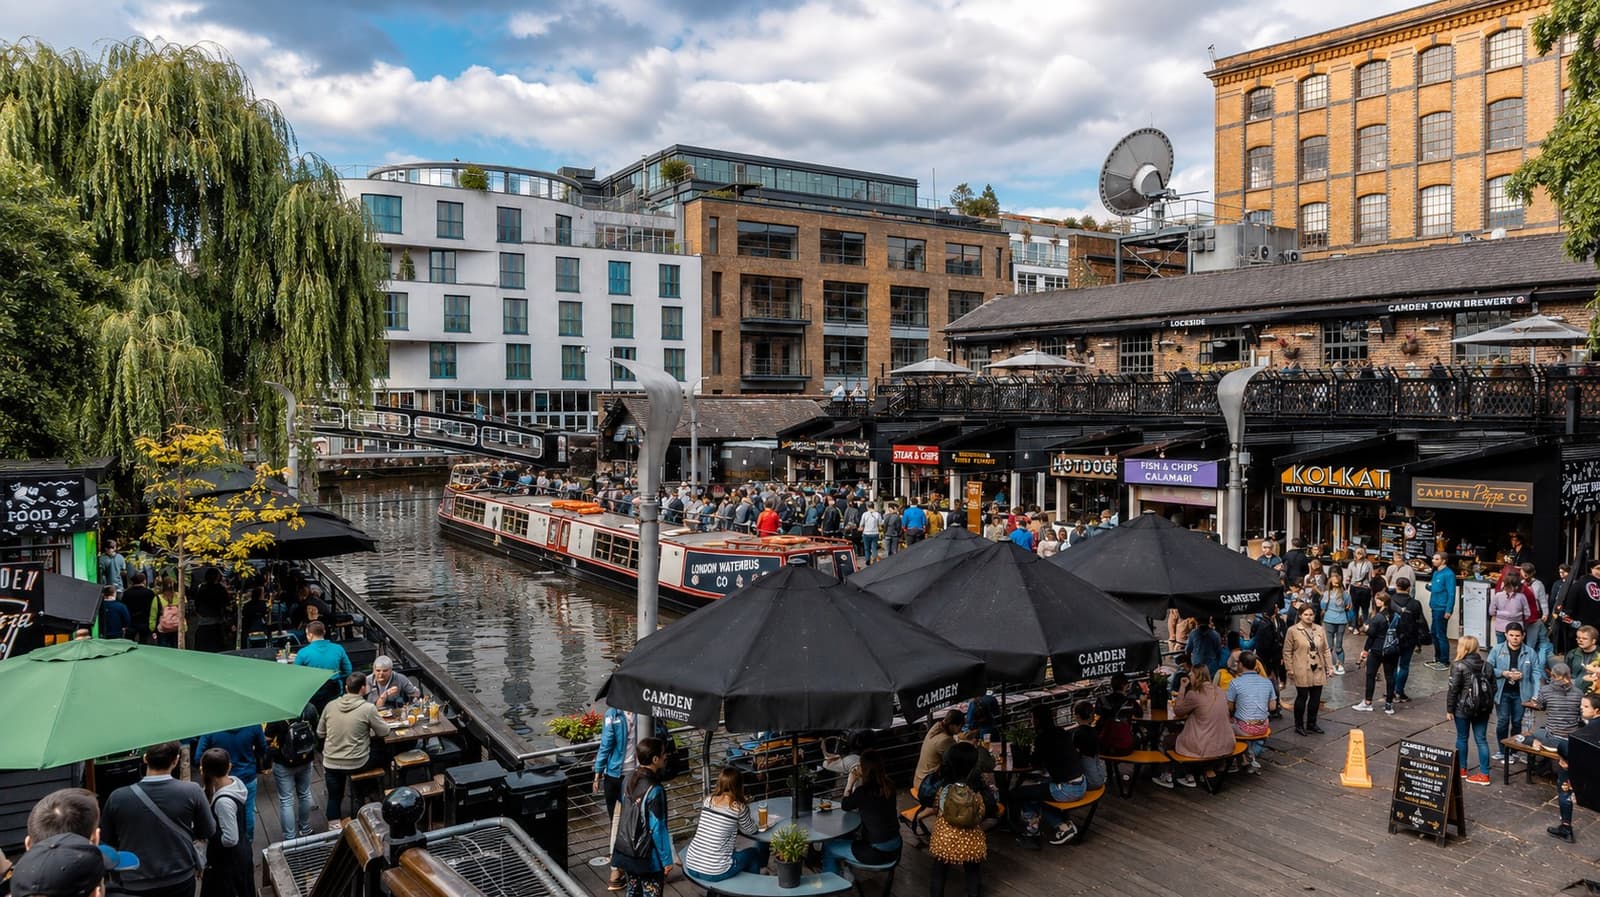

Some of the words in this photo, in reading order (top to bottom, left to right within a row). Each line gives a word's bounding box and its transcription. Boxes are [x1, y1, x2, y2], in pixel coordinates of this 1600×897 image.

[1388, 302, 1428, 312] CAMDEN
[1431, 299, 1461, 309] TOWN
[1463, 296, 1514, 308] BREWERY
[894, 450, 913, 460] STEAK
[1141, 462, 1160, 471] FISH
[1162, 463, 1169, 471] &
[1171, 463, 1199, 472] CHIPS
[1145, 472, 1193, 483] CALAMARI
[1417, 488, 1470, 499] CAMDEN
[1508, 493, 1528, 502] CO
[691, 562, 718, 574] LONDON
[716, 575, 728, 587] CO
[1078, 648, 1126, 665] CAMDEN
[1081, 661, 1126, 678] MARKET
[642, 688, 693, 711] CAMDEN
[916, 682, 959, 708] CAMDEN
